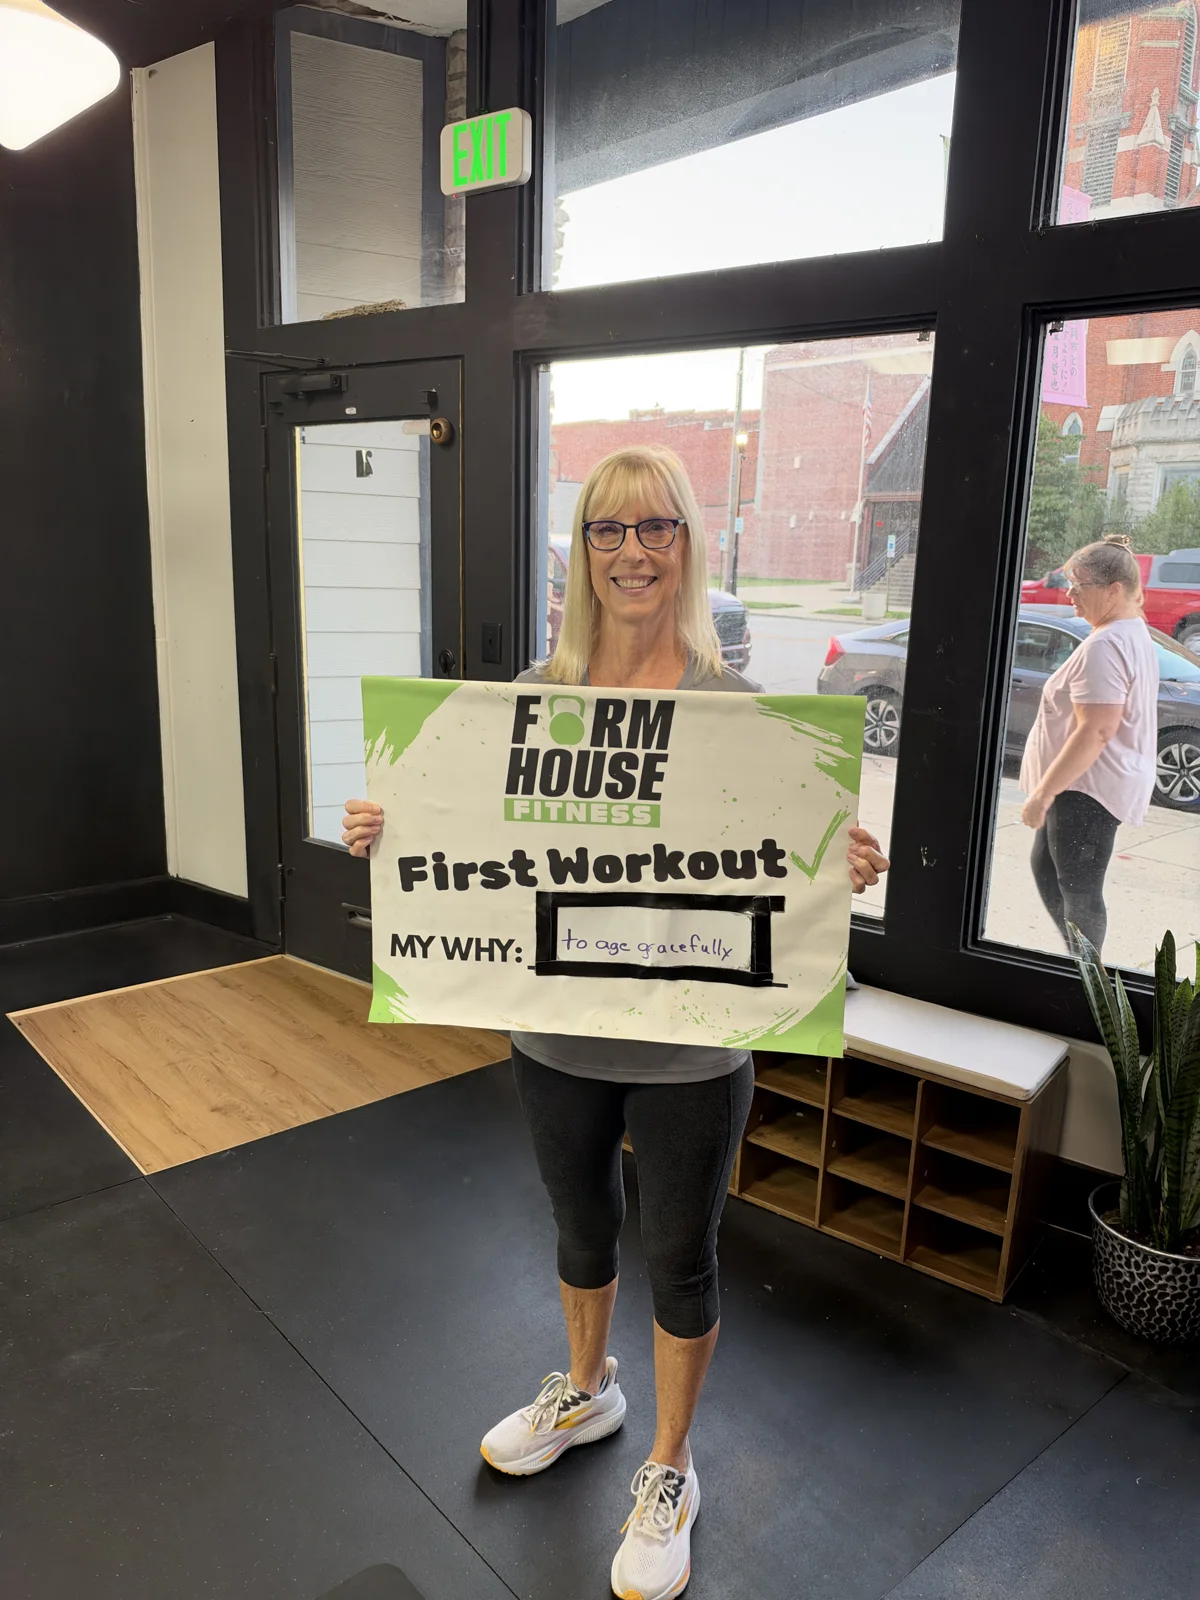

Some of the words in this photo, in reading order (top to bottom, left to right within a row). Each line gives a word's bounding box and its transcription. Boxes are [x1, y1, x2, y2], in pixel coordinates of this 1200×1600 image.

[453, 112, 511, 187] EXIT
[505, 748, 669, 801] HOUSE
[513, 800, 652, 826] FITNESS
[398, 850, 539, 893] First
[547, 838, 788, 885] Workout
[390, 933, 436, 959] MY
[441, 936, 523, 964] WHY:
[561, 928, 588, 951] to
[595, 939, 631, 956] age
[637, 933, 733, 961] gracefully
